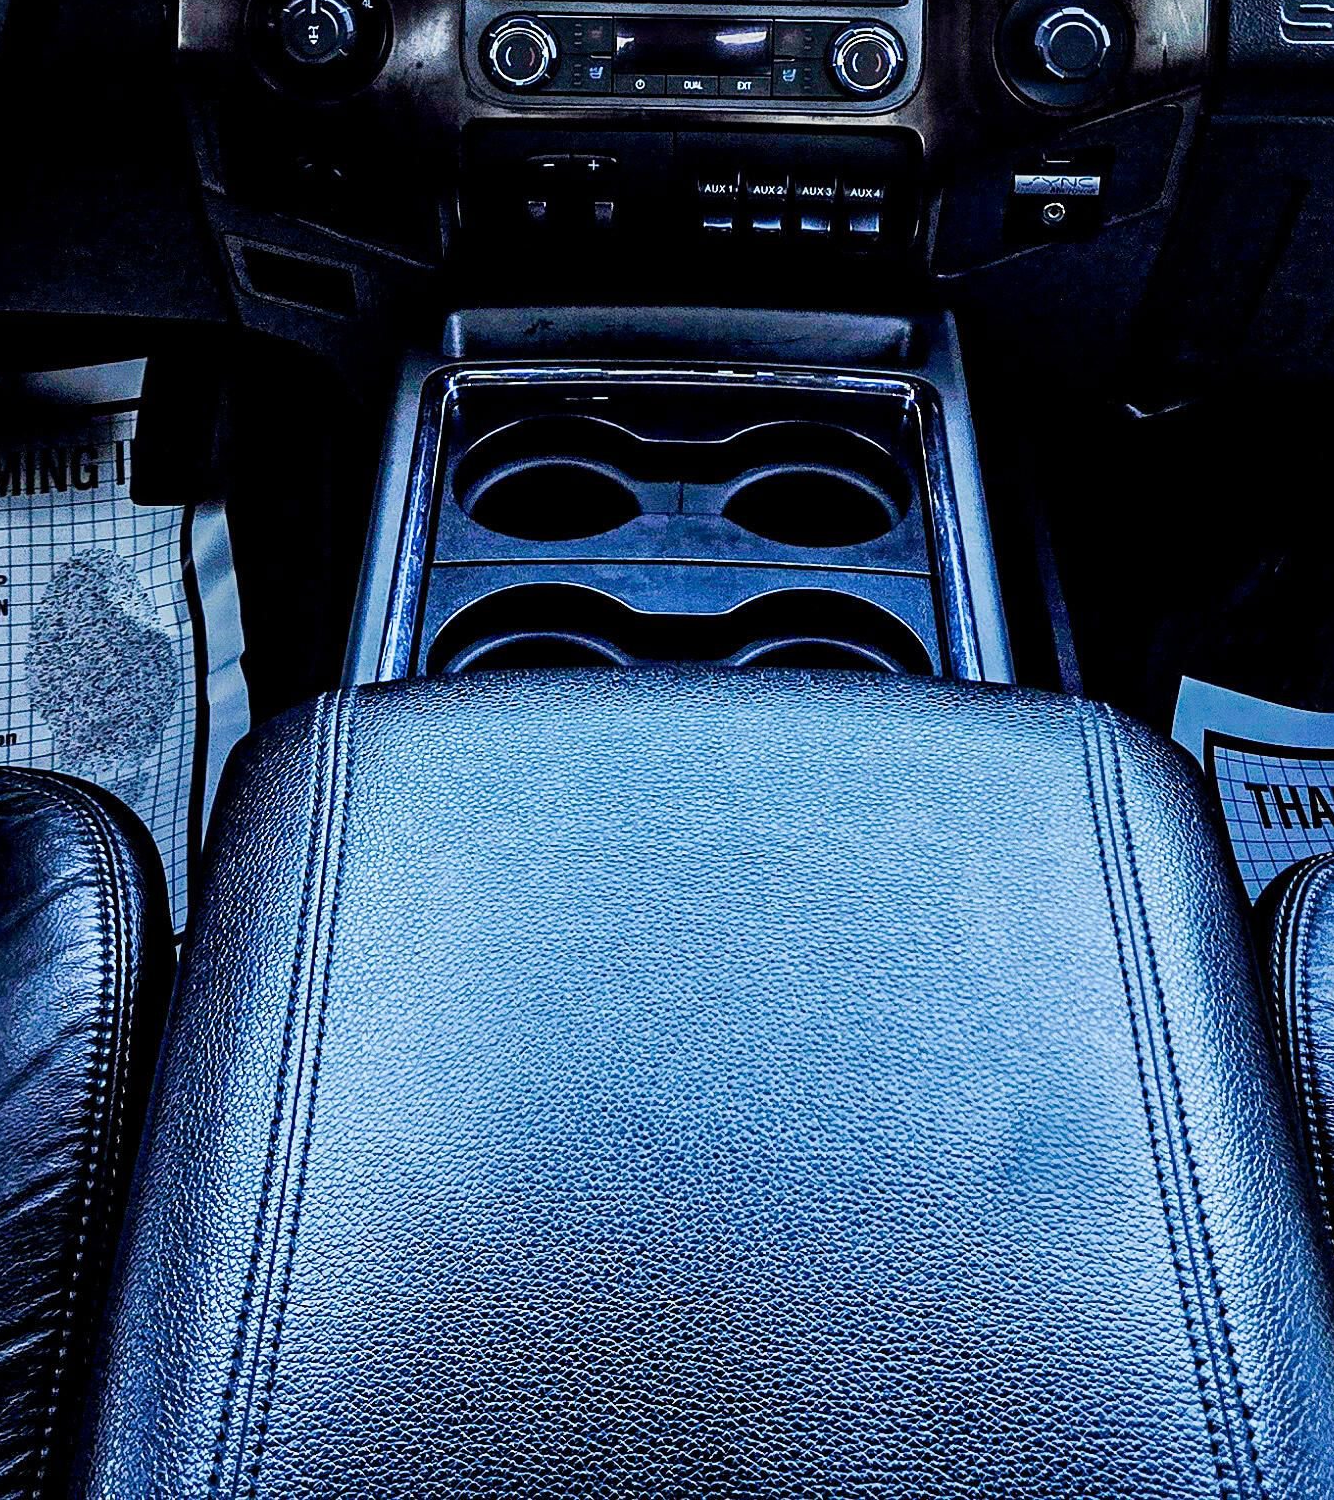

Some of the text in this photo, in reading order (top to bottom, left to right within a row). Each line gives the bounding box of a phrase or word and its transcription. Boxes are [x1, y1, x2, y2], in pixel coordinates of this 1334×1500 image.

[683, 81, 703, 91] DUAL
[737, 81, 752, 91] EXT
[1021, 176, 1094, 188] SYNC
[704, 184, 728, 194] AUX
[753, 186, 784, 195] AUX 2
[802, 187, 832, 197] AUX 3
[850, 188, 881, 198] AUX 4
